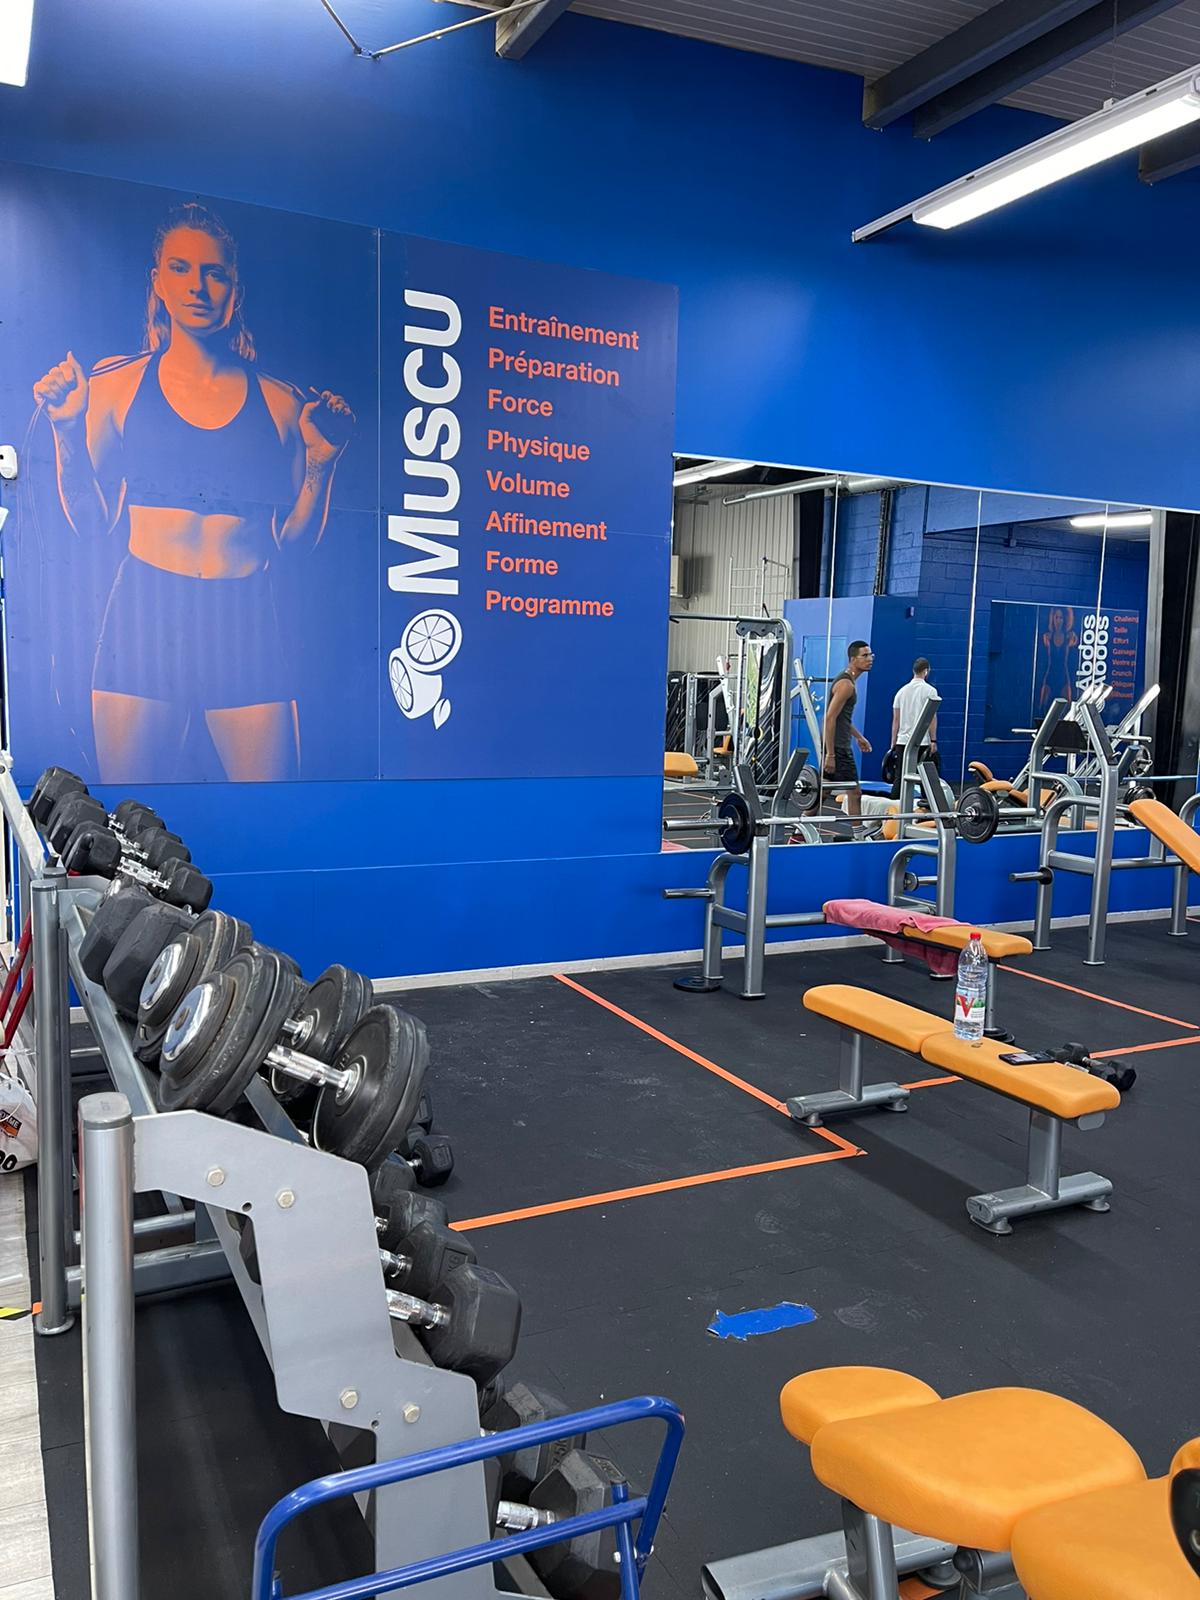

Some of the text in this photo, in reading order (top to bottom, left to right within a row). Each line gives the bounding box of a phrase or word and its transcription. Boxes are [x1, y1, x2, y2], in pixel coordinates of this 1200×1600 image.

[488, 305, 639, 351] Entraînement
[488, 347, 620, 386] Préparation
[488, 388, 553, 417] Force
[486, 429, 590, 463] Physique
[486, 470, 570, 498] Volume
[485, 511, 607, 541] Affinement
[485, 550, 558, 576] Forme
[485, 590, 614, 618] Programme
